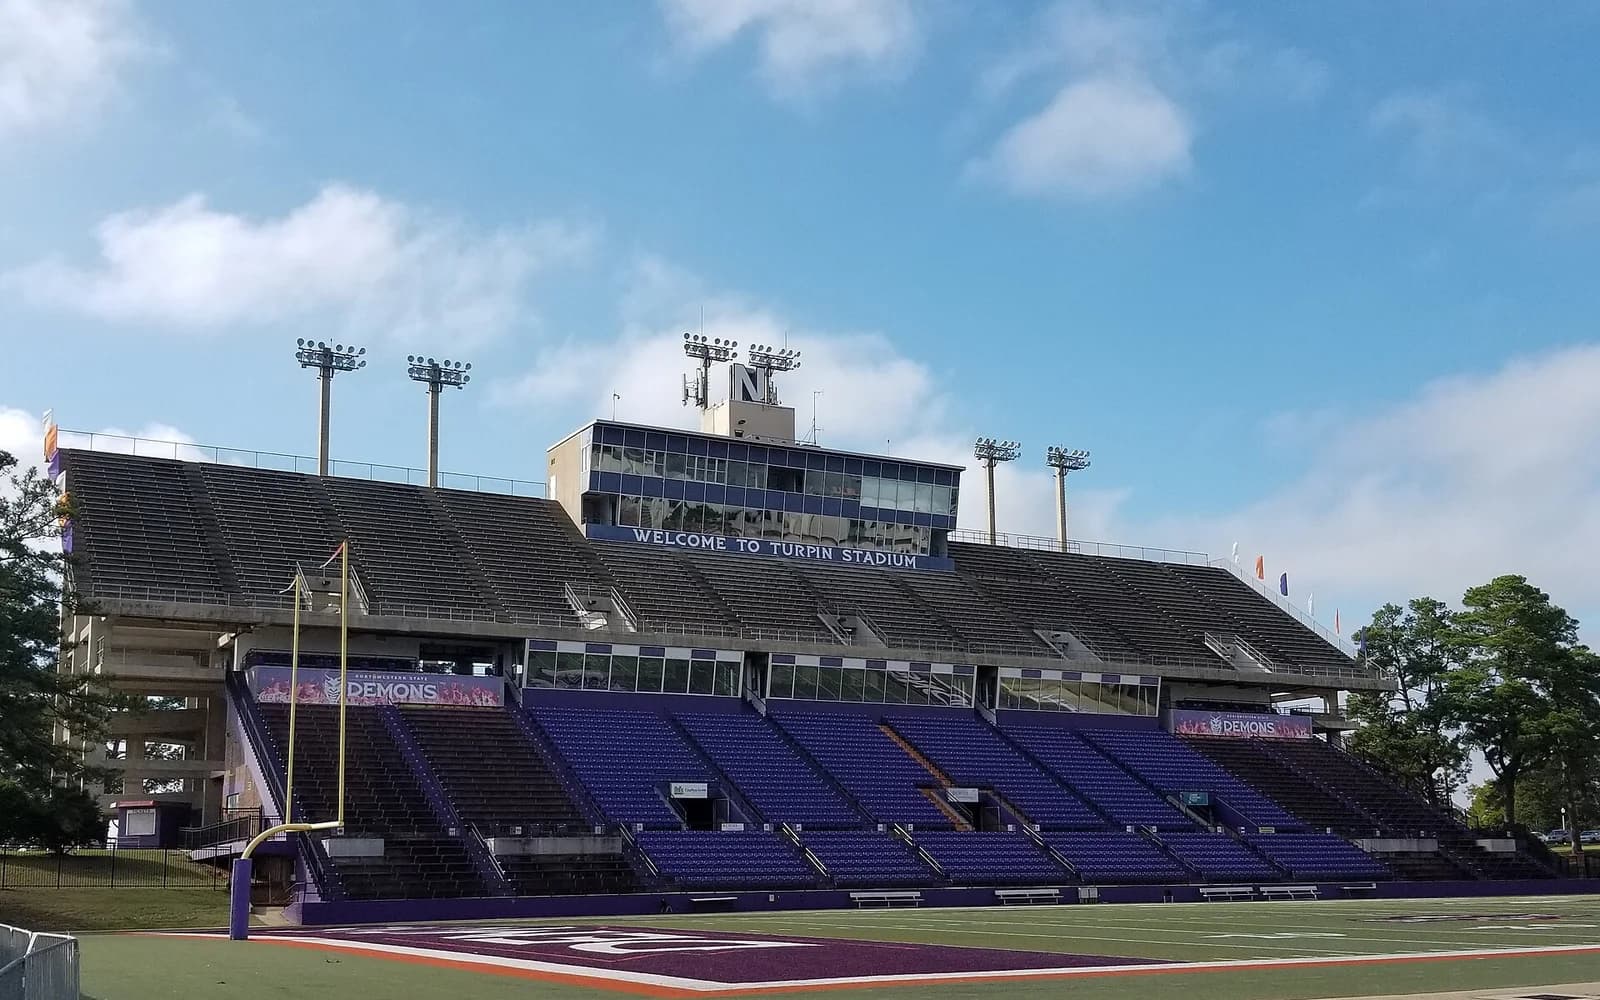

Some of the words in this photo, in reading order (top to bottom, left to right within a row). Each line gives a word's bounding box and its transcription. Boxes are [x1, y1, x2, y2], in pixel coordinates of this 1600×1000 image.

[734, 363, 765, 402] N
[633, 528, 727, 550] WELCOME
[736, 539, 760, 553] TO
[770, 542, 832, 559] TURPIN
[842, 549, 916, 568] STADIUM
[347, 682, 437, 700] DEMONS
[1223, 720, 1275, 733] DEMONS
